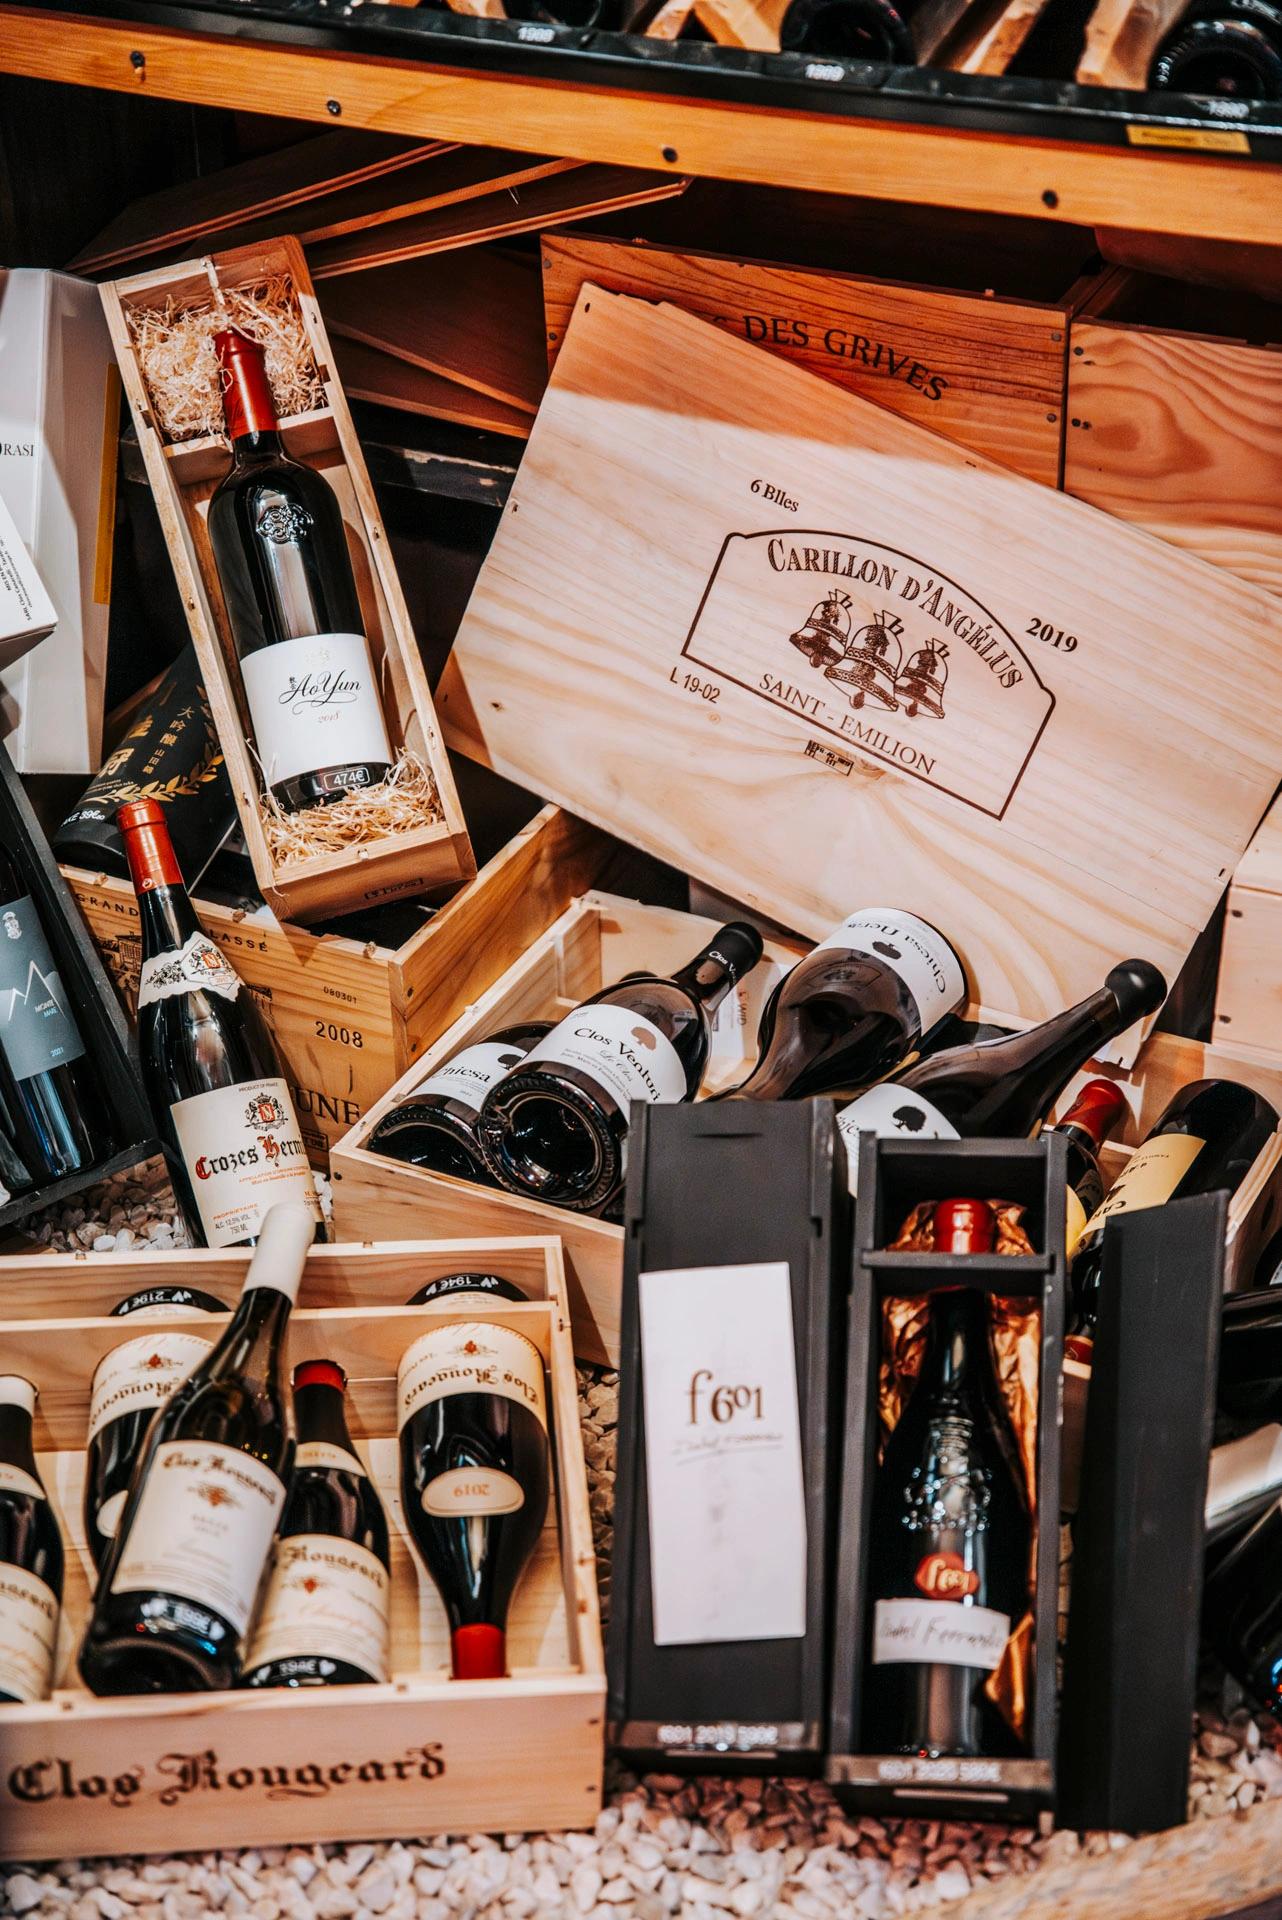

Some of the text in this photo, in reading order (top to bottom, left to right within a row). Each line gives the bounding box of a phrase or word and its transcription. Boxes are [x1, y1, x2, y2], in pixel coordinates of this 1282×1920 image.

[743, 315, 949, 401] DES GRIVES
[750, 479, 763, 493] 6
[1025, 617, 1078, 653] 2019
[669, 666, 721, 705] L 19-02
[759, 673, 826, 722] SAINT
[840, 715, 937, 775] EMILION
[333, 770, 365, 786] 474€
[75, 893, 139, 917] GRAND
[208, 928, 269, 953] LASSÉ
[323, 985, 357, 1004] 080301
[315, 1021, 363, 1049] 2008
[573, 1027, 662, 1103] Clos Venturi
[195, 1144, 260, 1181] Crozes
[439, 1275, 472, 1291] 194€
[132, 1290, 165, 1307] 219€
[404, 1366, 498, 1410] Rougeard
[503, 1371, 539, 1404] Clos
[453, 1484, 490, 1498] 2019
[7, 1742, 446, 1808] Clos Rougeard
